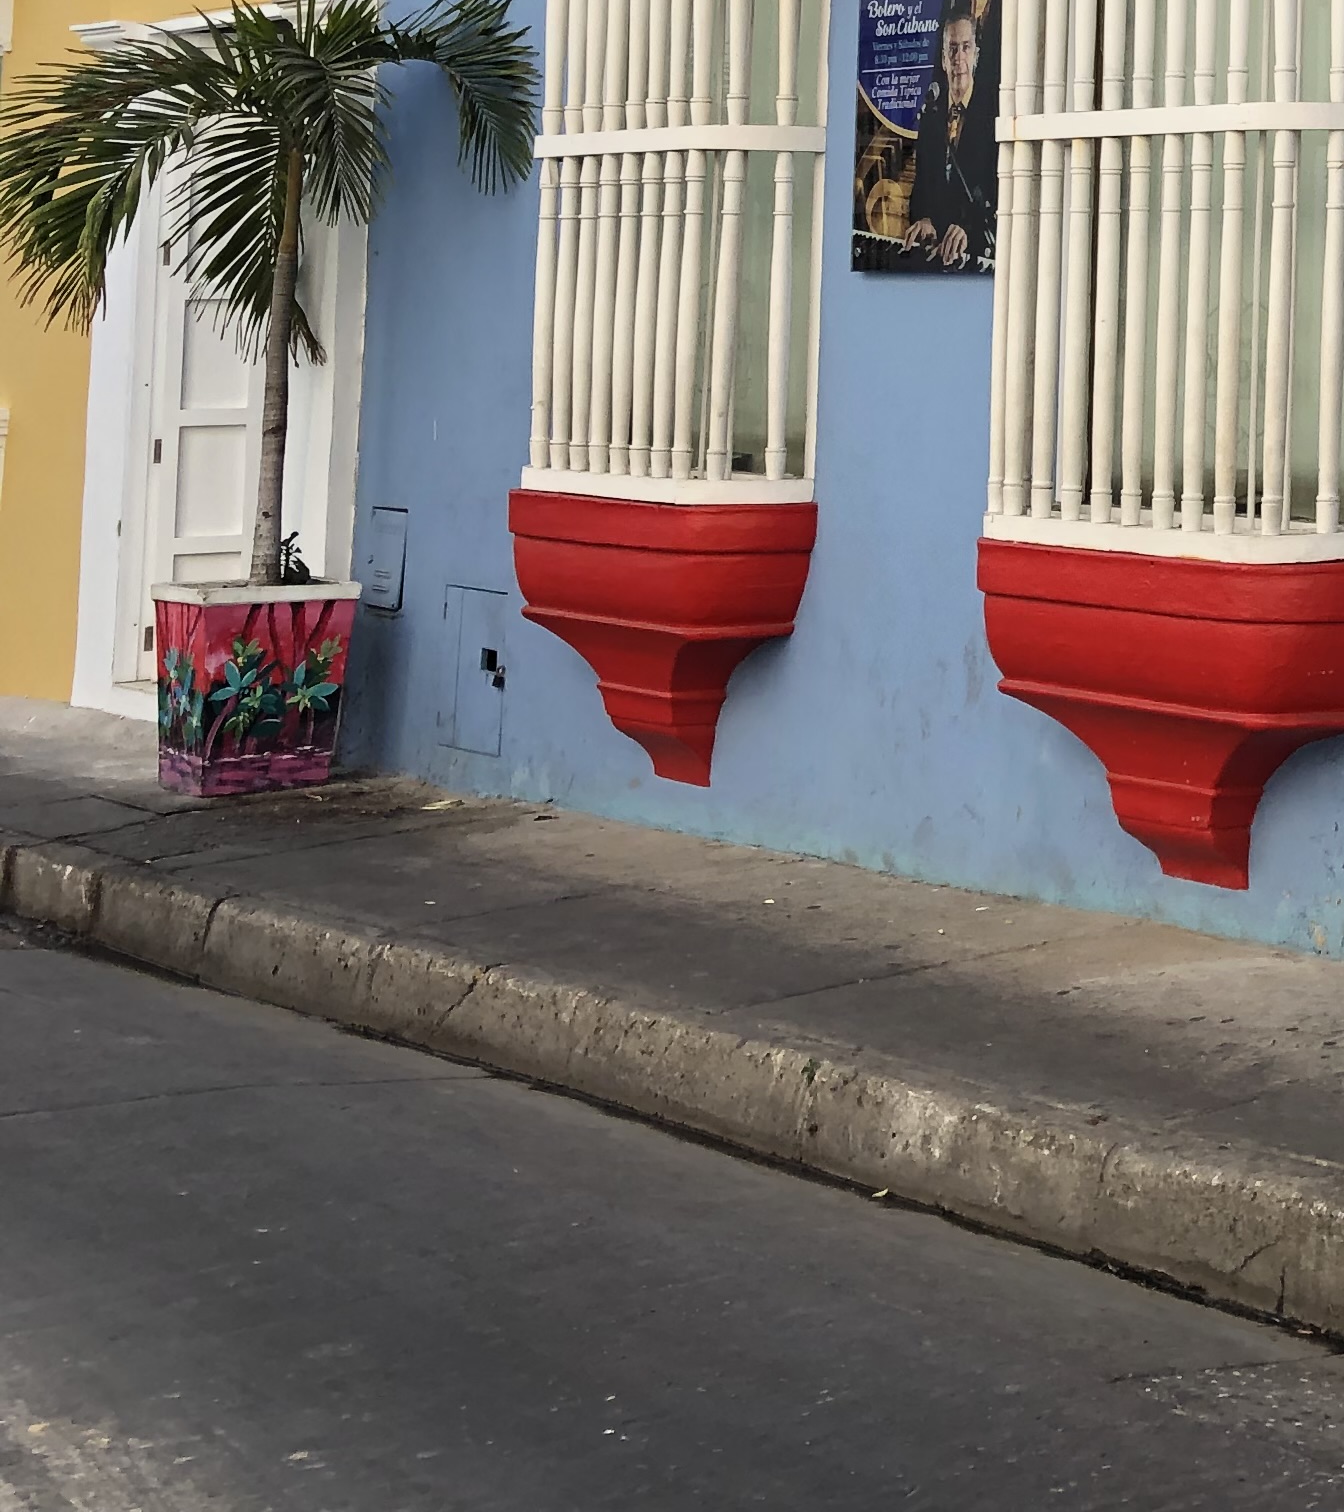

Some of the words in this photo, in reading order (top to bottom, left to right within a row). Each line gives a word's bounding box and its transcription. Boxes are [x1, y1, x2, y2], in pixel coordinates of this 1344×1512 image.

[868, 0, 904, 18] Bolero
[906, 6, 912, 20] y
[914, 0, 922, 14] el
[876, 20, 896, 36] Son
[898, 16, 938, 34] Cubano
[876, 74, 890, 86] Con
